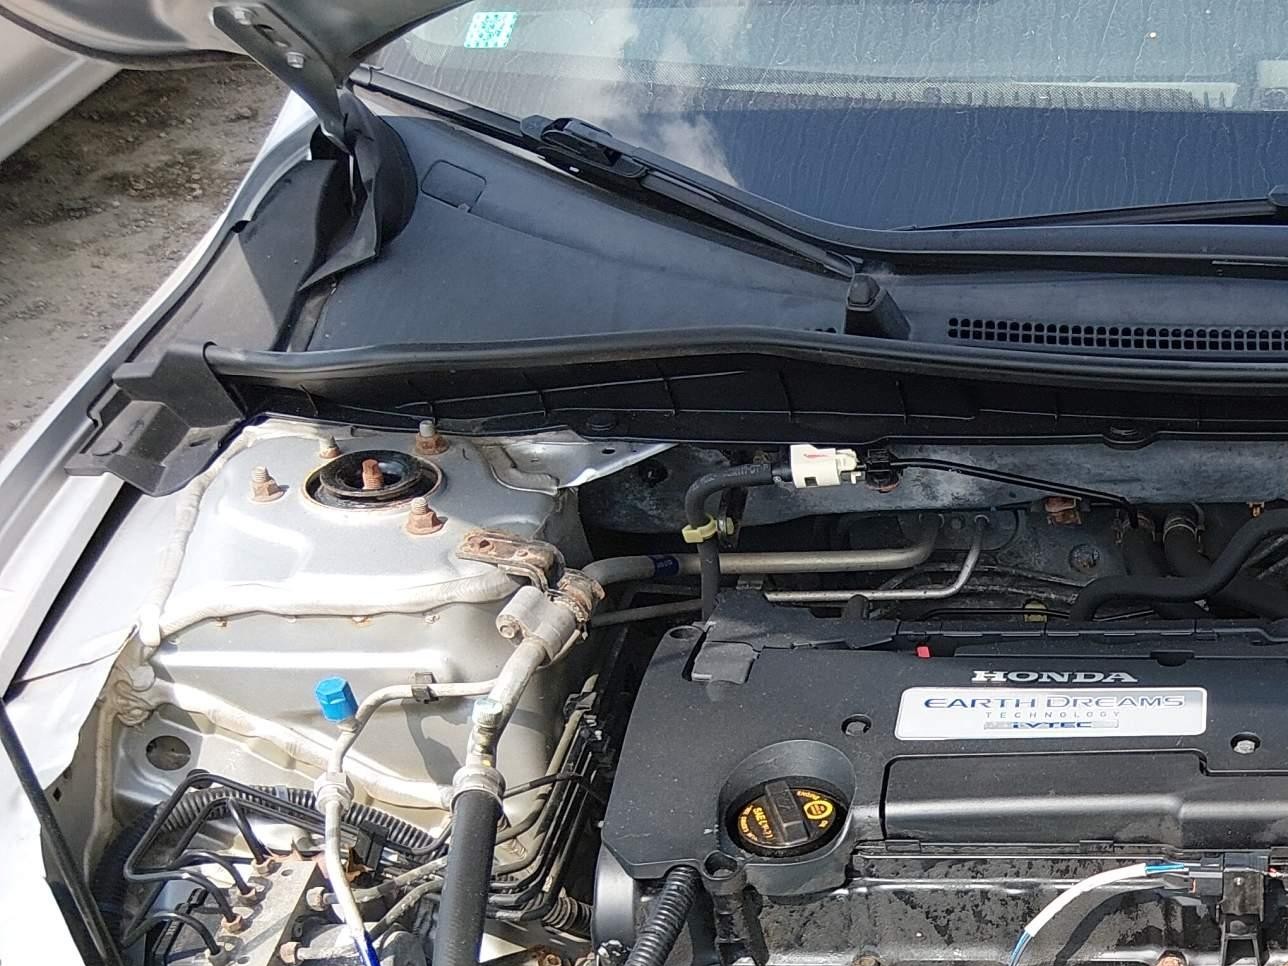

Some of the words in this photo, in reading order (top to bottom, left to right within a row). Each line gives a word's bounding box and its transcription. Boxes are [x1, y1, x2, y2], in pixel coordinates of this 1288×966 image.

[972, 671, 1137, 682] HONDA
[924, 697, 1035, 708] EARTH
[1046, 695, 1183, 709] DREAMS
[986, 711, 1120, 719] TECHNOLOGY
